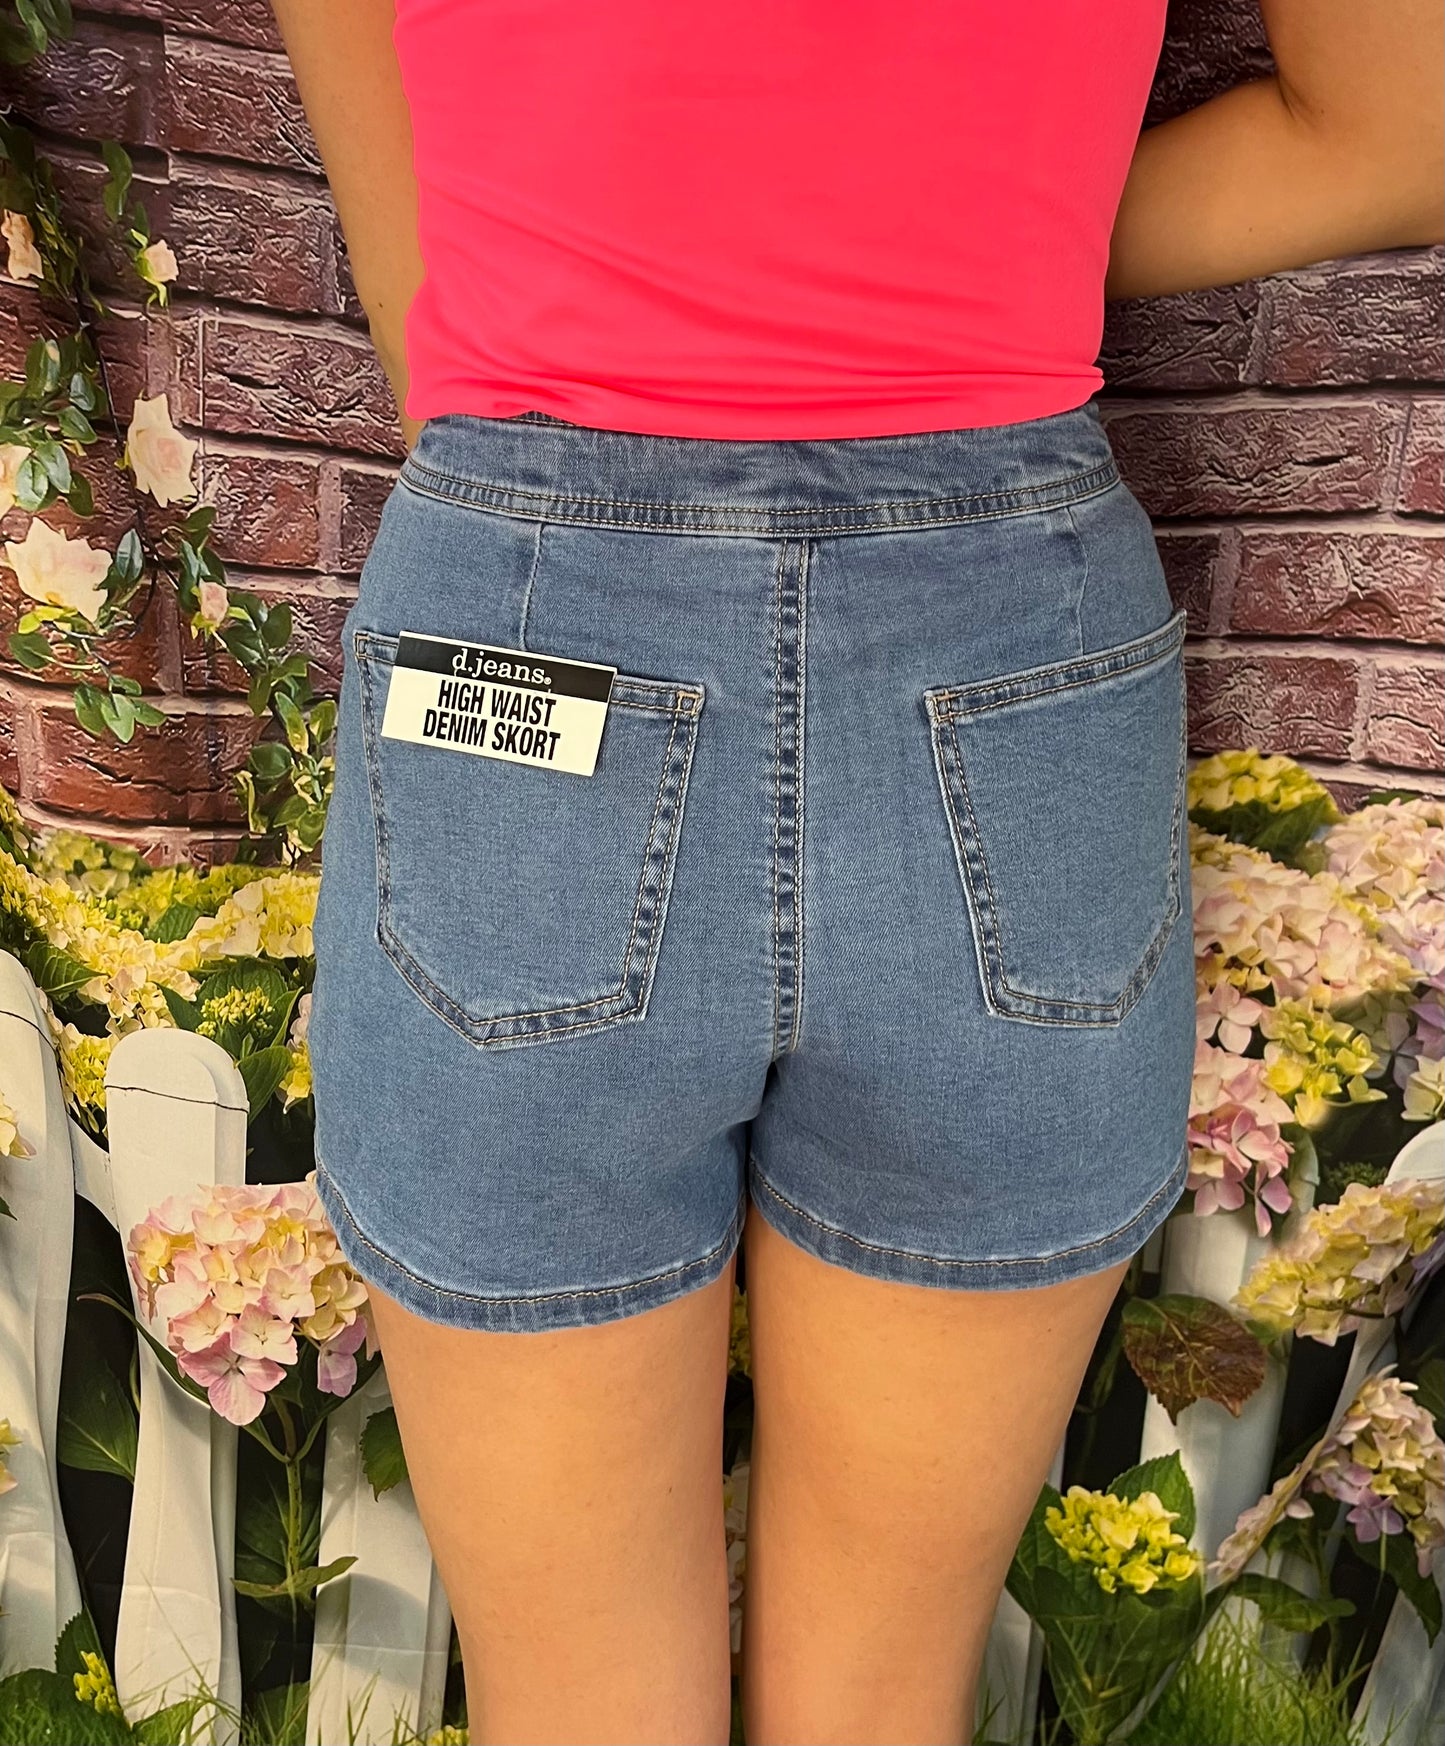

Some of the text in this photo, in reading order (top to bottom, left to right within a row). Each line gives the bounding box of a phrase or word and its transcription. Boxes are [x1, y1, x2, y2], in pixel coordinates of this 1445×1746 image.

[437, 679, 556, 727] HIGH WAIST
[423, 709, 560, 760] DENIM SKORT
